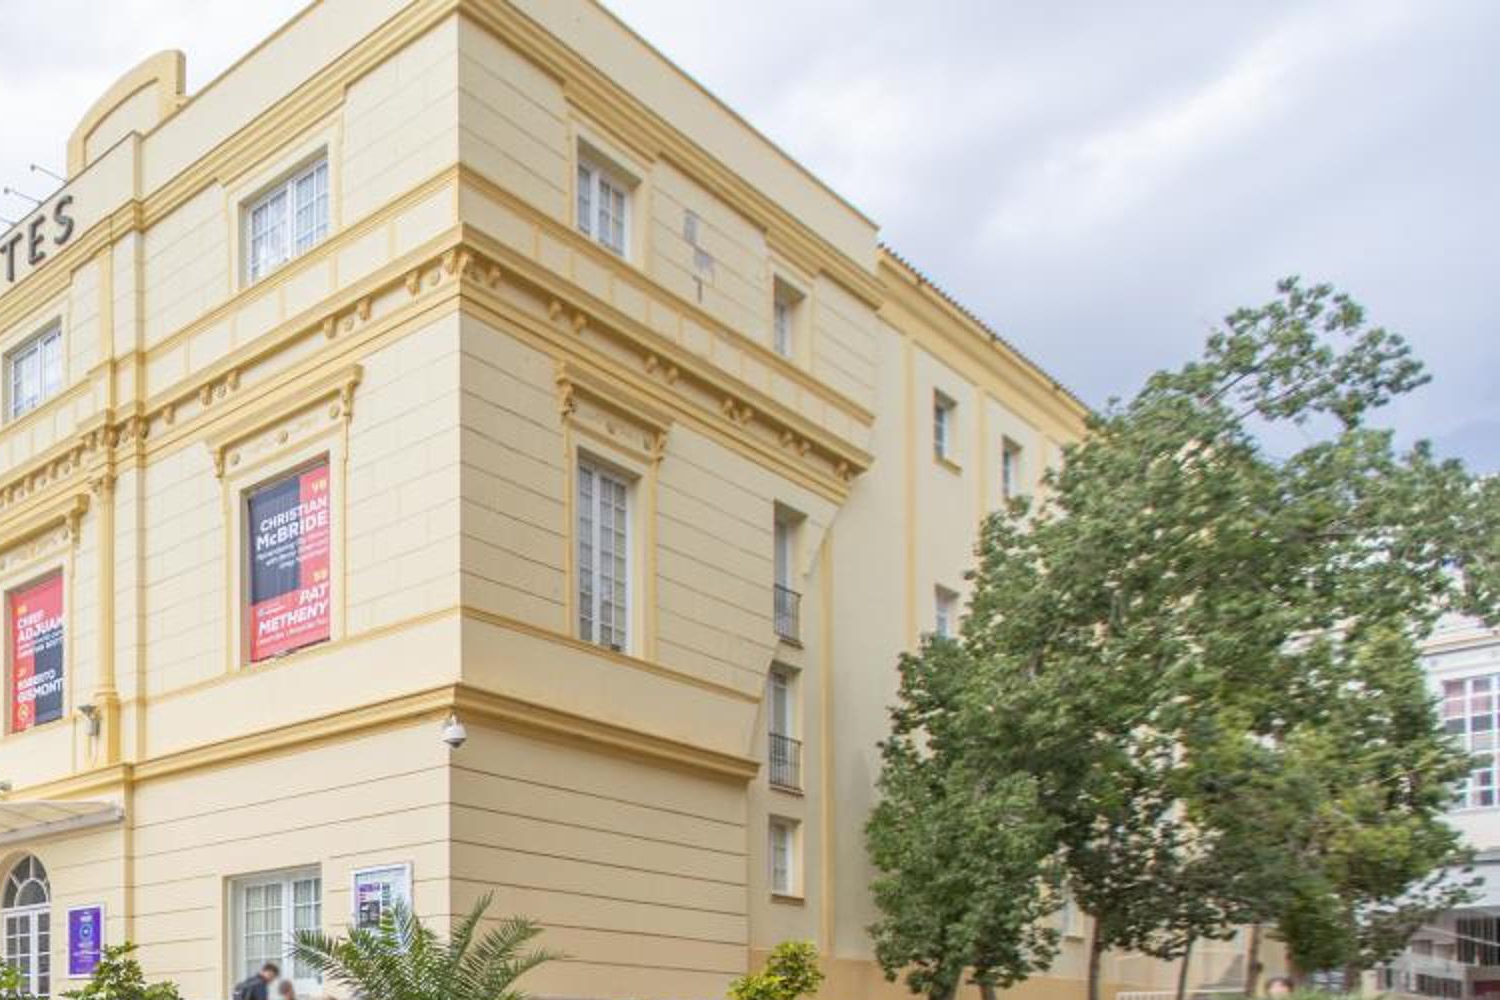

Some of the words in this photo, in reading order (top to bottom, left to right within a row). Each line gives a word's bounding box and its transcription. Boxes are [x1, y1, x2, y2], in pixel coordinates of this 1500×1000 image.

[256, 510, 328, 551] McBRIDE
[260, 496, 327, 532] CHRISTIAN
[300, 582, 329, 606] PAT
[258, 598, 329, 637] METHENY
